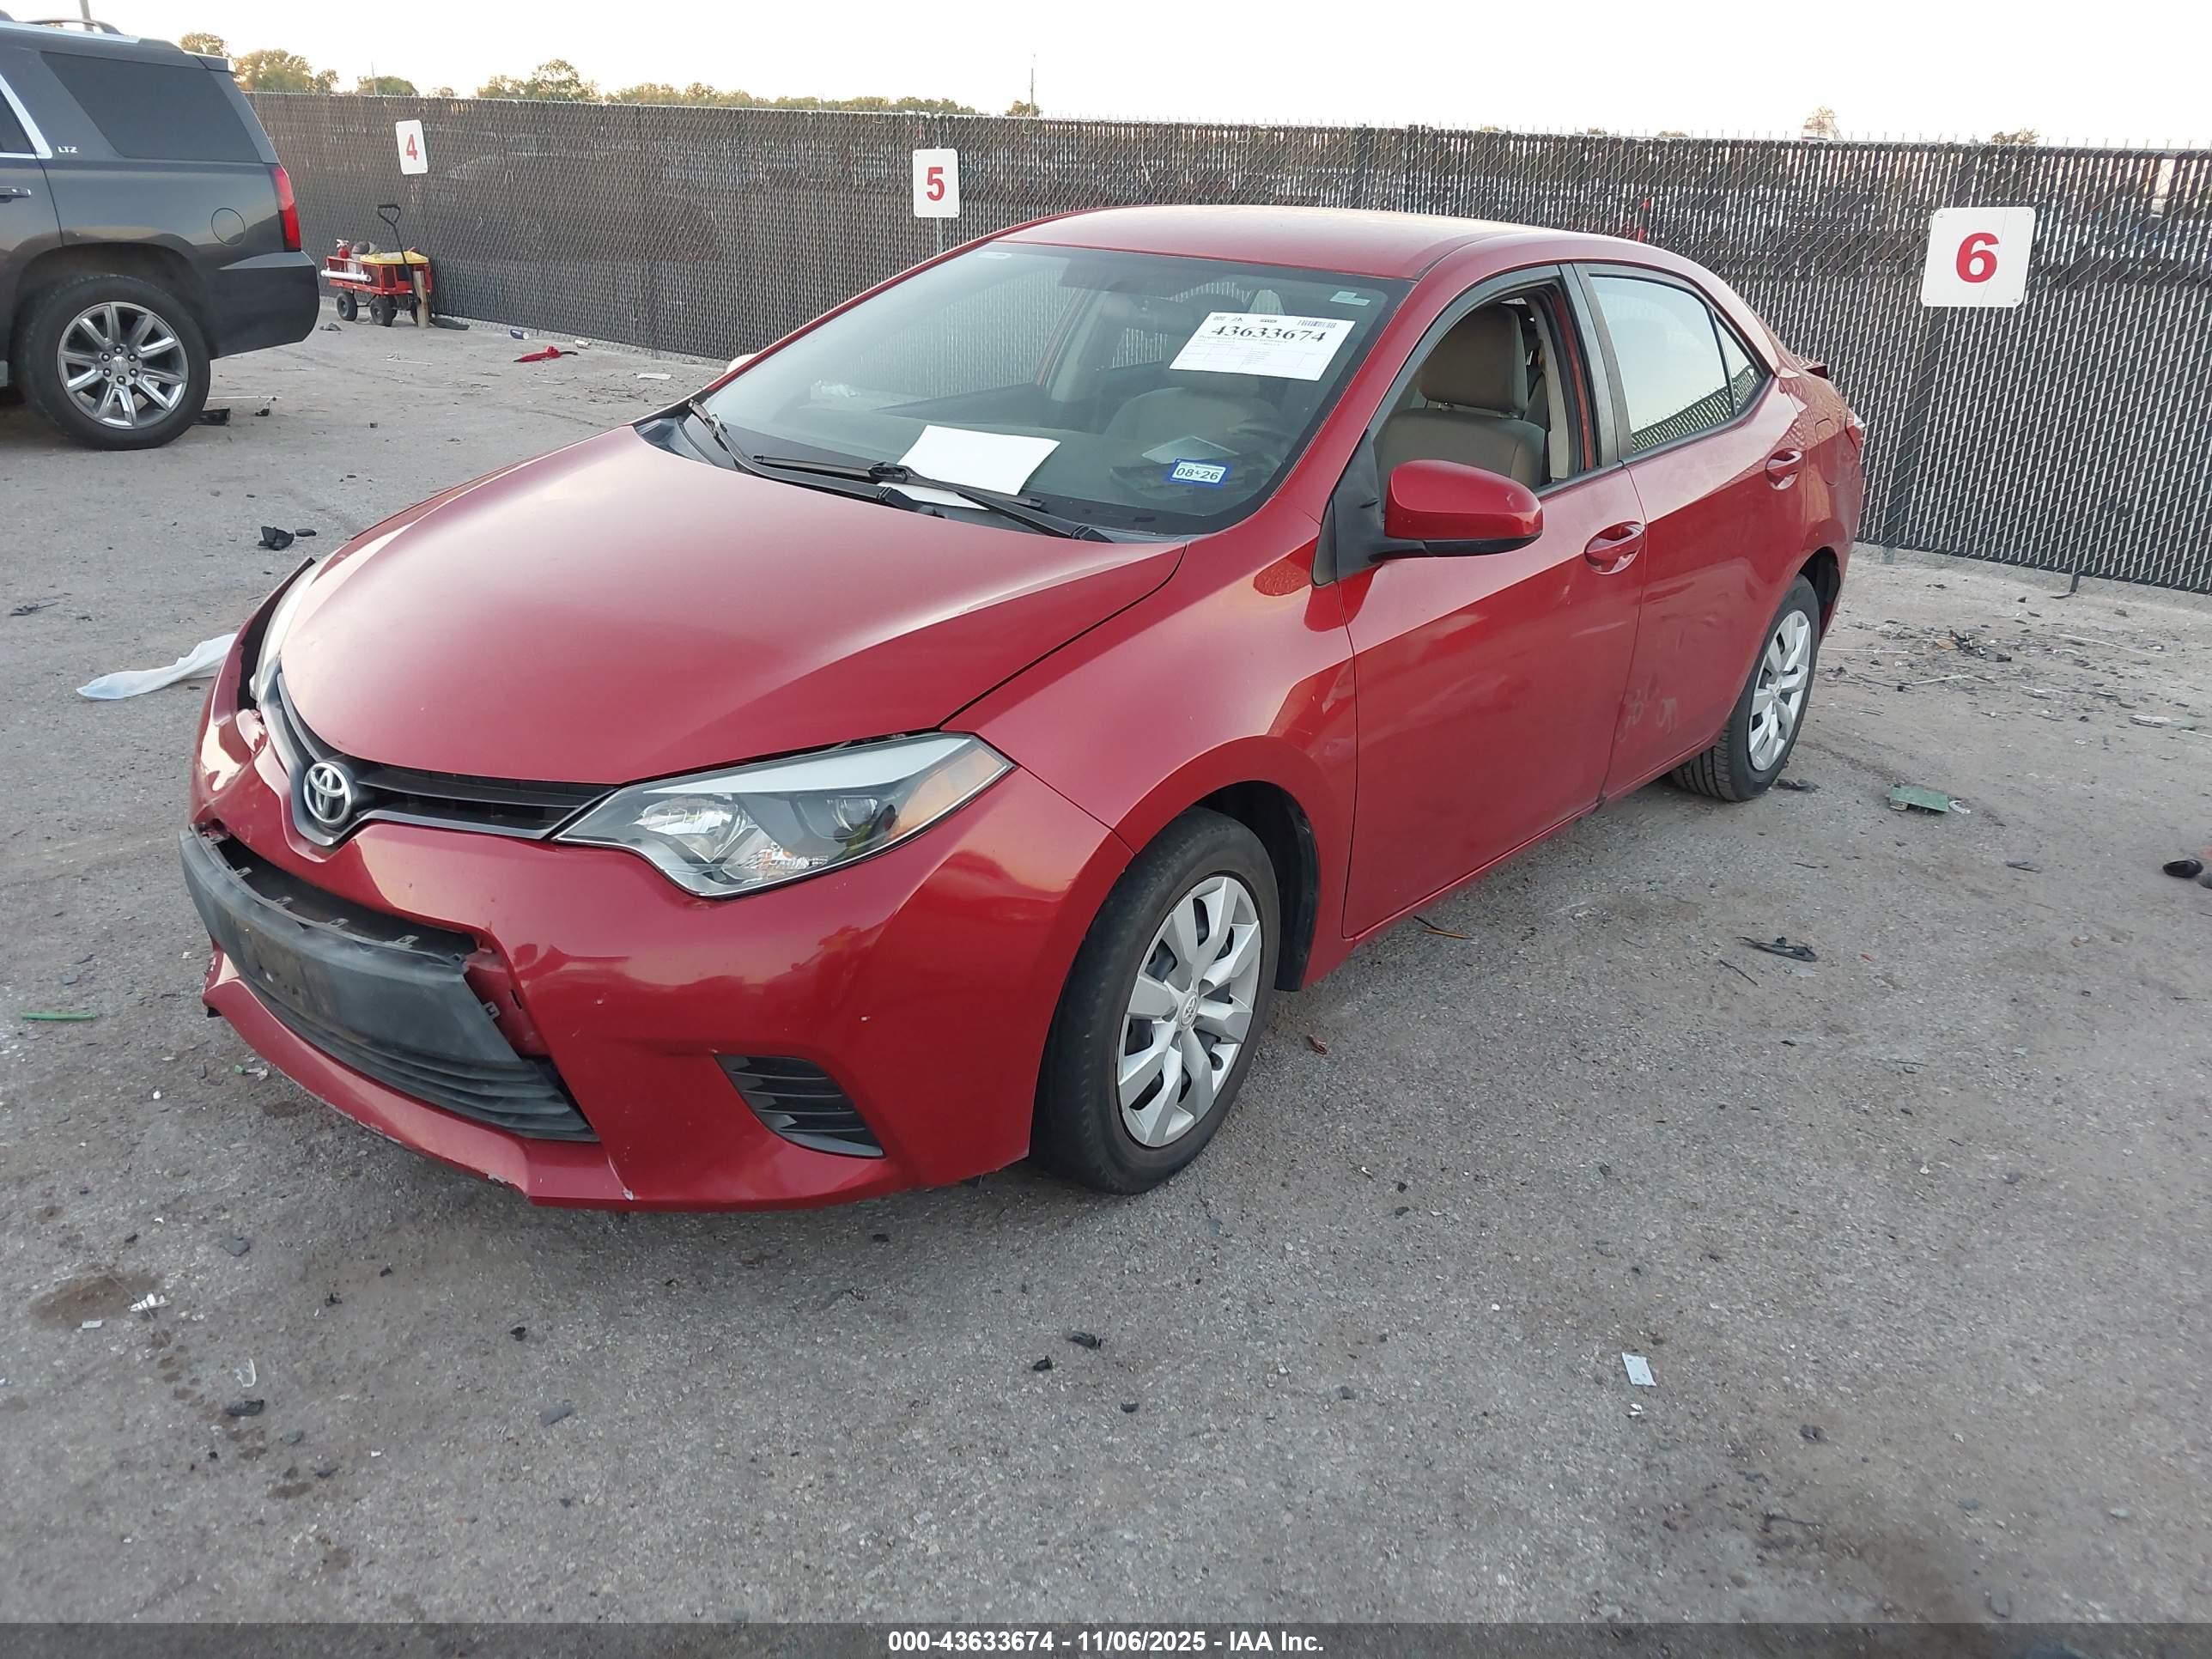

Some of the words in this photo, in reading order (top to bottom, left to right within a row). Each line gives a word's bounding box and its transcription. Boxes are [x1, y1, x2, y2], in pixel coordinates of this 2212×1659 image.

[58, 145, 78, 154] LTZ
[405, 133, 418, 161] 4
[927, 167, 945, 202] 5
[1955, 232, 2000, 283] 6
[1211, 325, 1327, 343] 43633674
